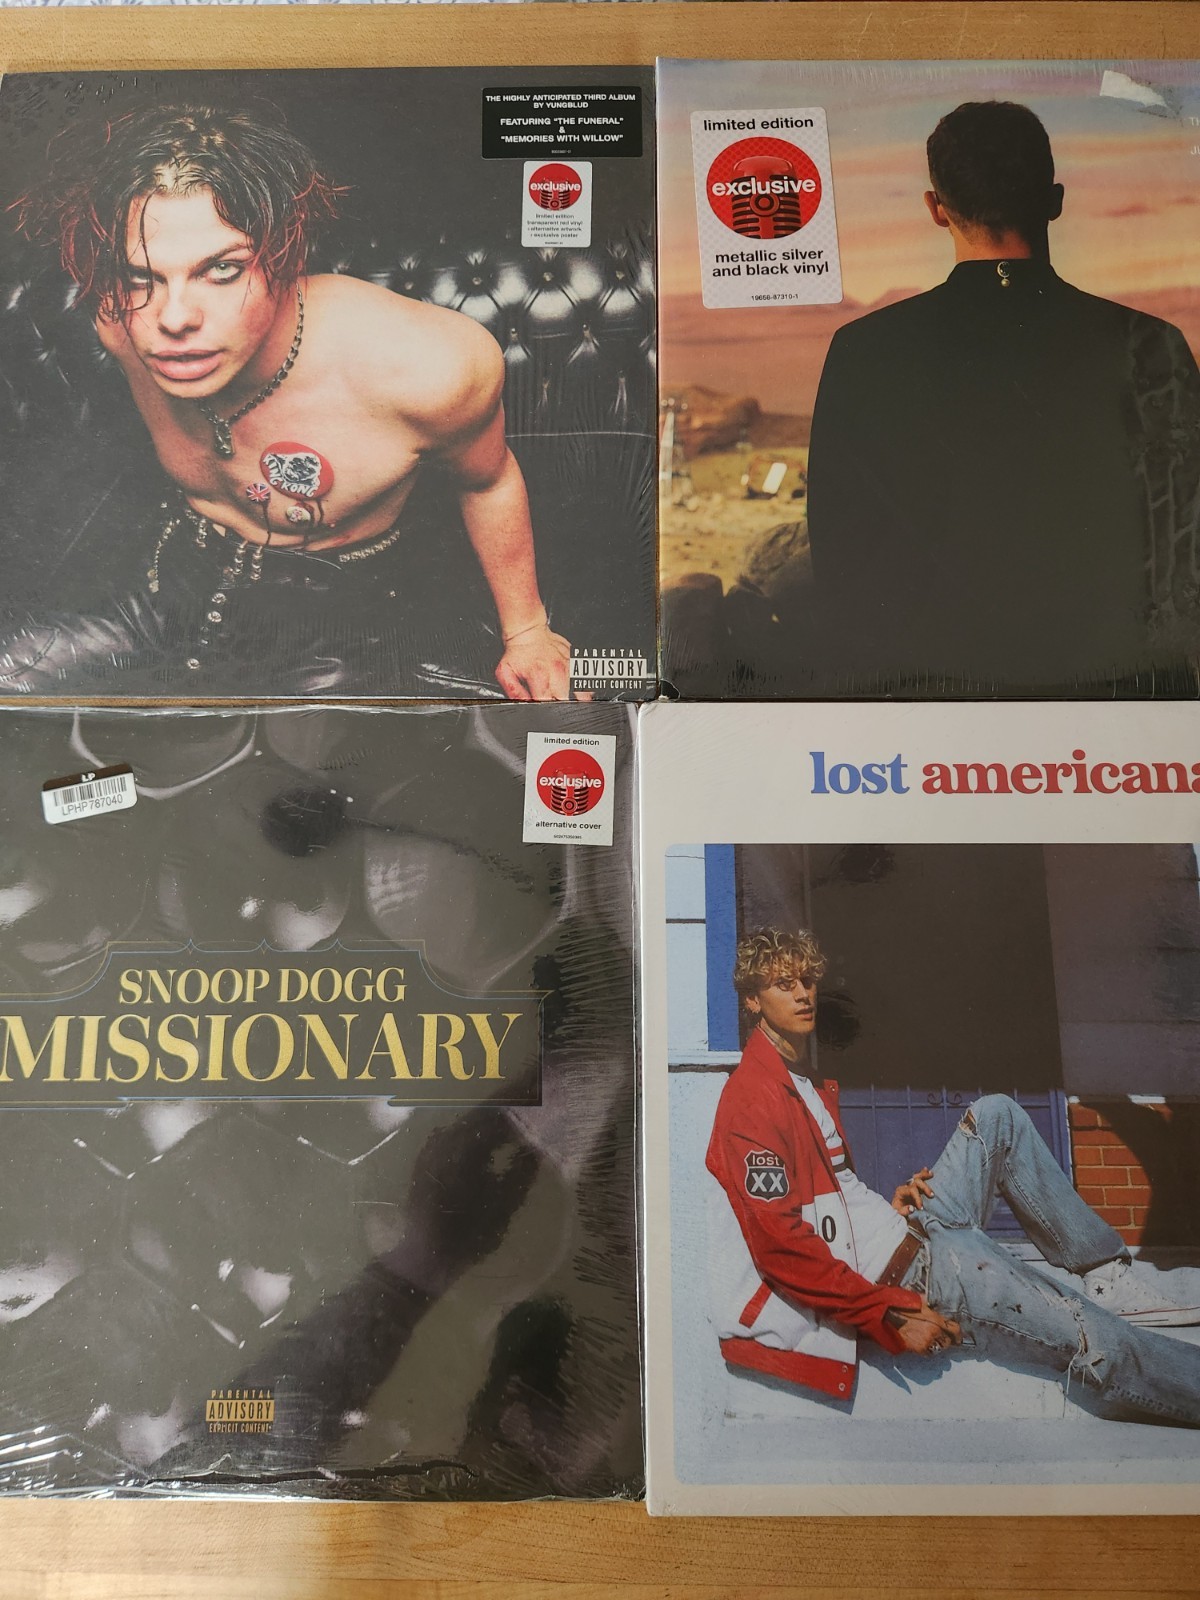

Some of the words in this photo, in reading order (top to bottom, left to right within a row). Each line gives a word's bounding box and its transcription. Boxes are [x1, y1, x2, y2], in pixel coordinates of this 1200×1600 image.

[703, 118, 756, 131] limited
[760, 117, 814, 130] edition
[530, 181, 581, 191] exclusive
[712, 176, 816, 196] exclusive
[715, 250, 777, 263] metallic
[782, 248, 824, 261] silver
[712, 264, 741, 277] and
[746, 263, 788, 276] black
[794, 262, 829, 276] vinyl
[263, 454, 283, 486] KING
[281, 482, 318, 497] KONG
[574, 648, 642, 658] PARENTAL
[573, 660, 644, 676] ADVISORY
[574, 680, 606, 689] EXPLICIT
[610, 680, 642, 689] CONTENT
[81, 772, 96, 782] LP
[808, 751, 910, 794] lost
[922, 749, 1200, 794] american
[540, 774, 602, 788] exclusive
[536, 821, 578, 829] alternative
[118, 967, 270, 1004] SNOOP
[278, 967, 408, 1003] DOGG
[0, 1012, 524, 1082] MISSIONARY
[752, 1154, 780, 1166] lost
[750, 1172, 784, 1192] XX
[211, 1390, 271, 1399] PARENTAL
[208, 1402, 271, 1420] ADVISORY
[209, 1423, 238, 1433] EXPLICIT
[240, 1423, 269, 1433] CONTENT
